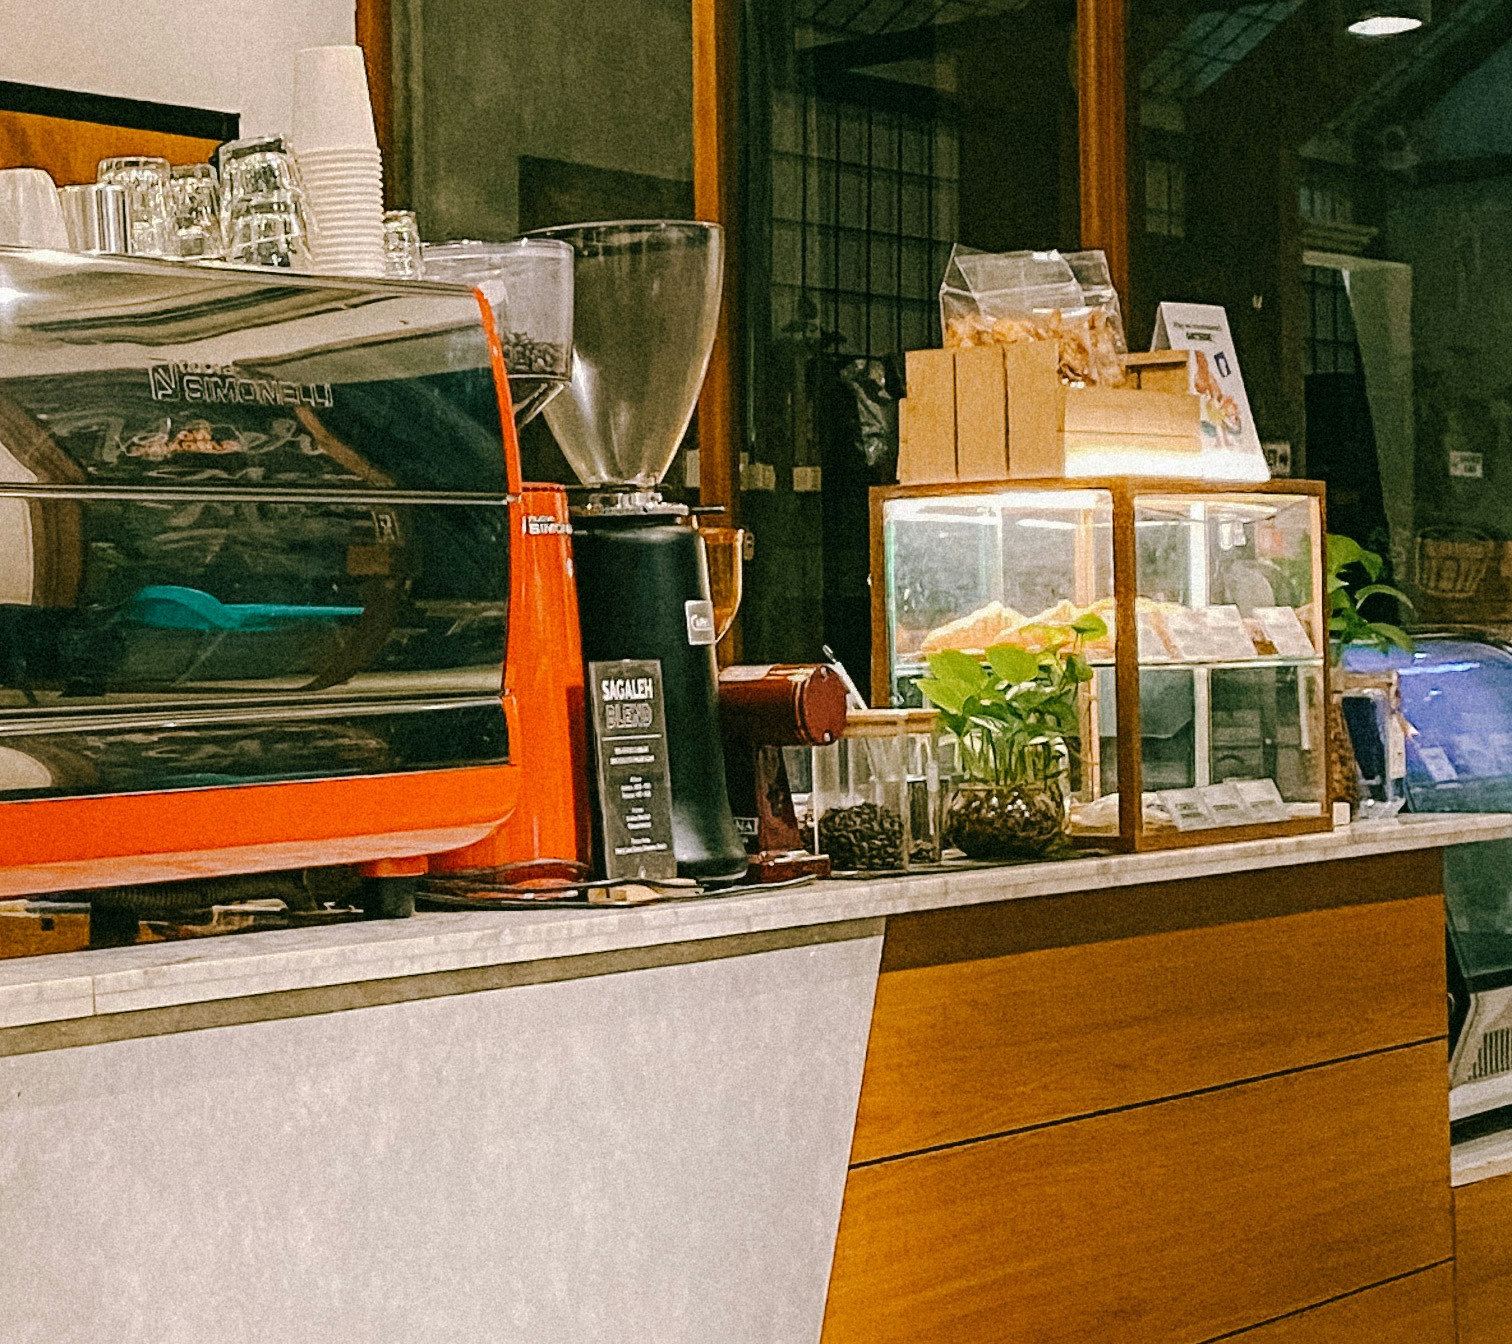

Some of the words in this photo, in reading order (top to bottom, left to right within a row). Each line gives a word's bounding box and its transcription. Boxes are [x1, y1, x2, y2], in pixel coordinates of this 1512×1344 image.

[183, 375, 334, 407] SIMONELLI
[601, 678, 654, 702] SAGALEH
[605, 703, 653, 729] BLEND
